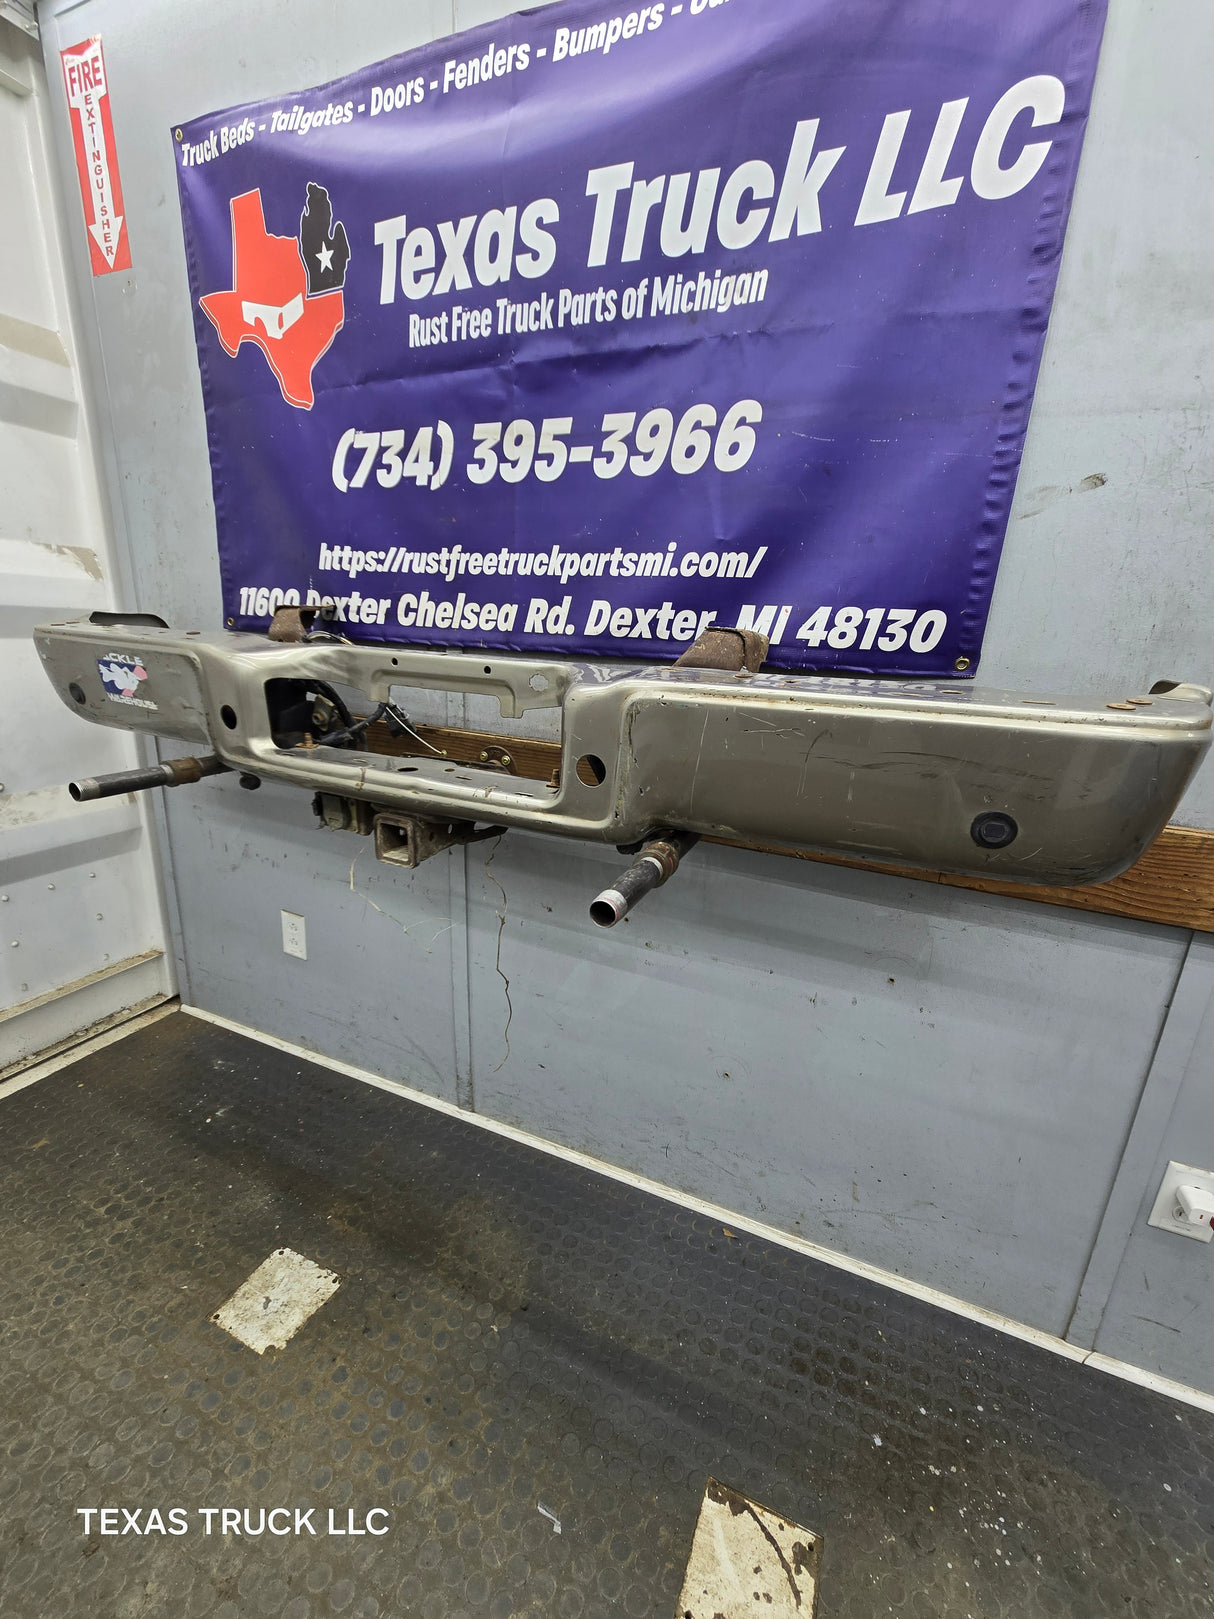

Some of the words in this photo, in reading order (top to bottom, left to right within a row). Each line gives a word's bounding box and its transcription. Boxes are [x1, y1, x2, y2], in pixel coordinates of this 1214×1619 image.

[68, 56, 102, 97] FIRE
[181, 129, 219, 167] Truck
[221, 118, 254, 154] Beds
[270, 101, 353, 135] Tailgates
[370, 76, 424, 116] Doors
[443, 42, 530, 93] Fenders
[552, 1, 665, 62] Bumpers
[84, 94, 114, 257] EXTINGUISHER
[374, 198, 560, 305] Texas
[585, 118, 847, 268] Truck
[854, 75, 1066, 226] LLC
[409, 311, 448, 348] Rust
[451, 305, 492, 341] Free
[496, 292, 554, 334] Truck
[558, 286, 617, 327] Parts
[621, 277, 649, 319] of
[650, 269, 768, 316] Michigan
[332, 419, 454, 493] (734)
[466, 399, 763, 484] 395-3966
[318, 542, 768, 584] https://rustfreetruckpartsmi.com/
[397, 591, 515, 632] Chelsea
[524, 596, 575, 635] Rd.
[796, 605, 948, 654] 48130
